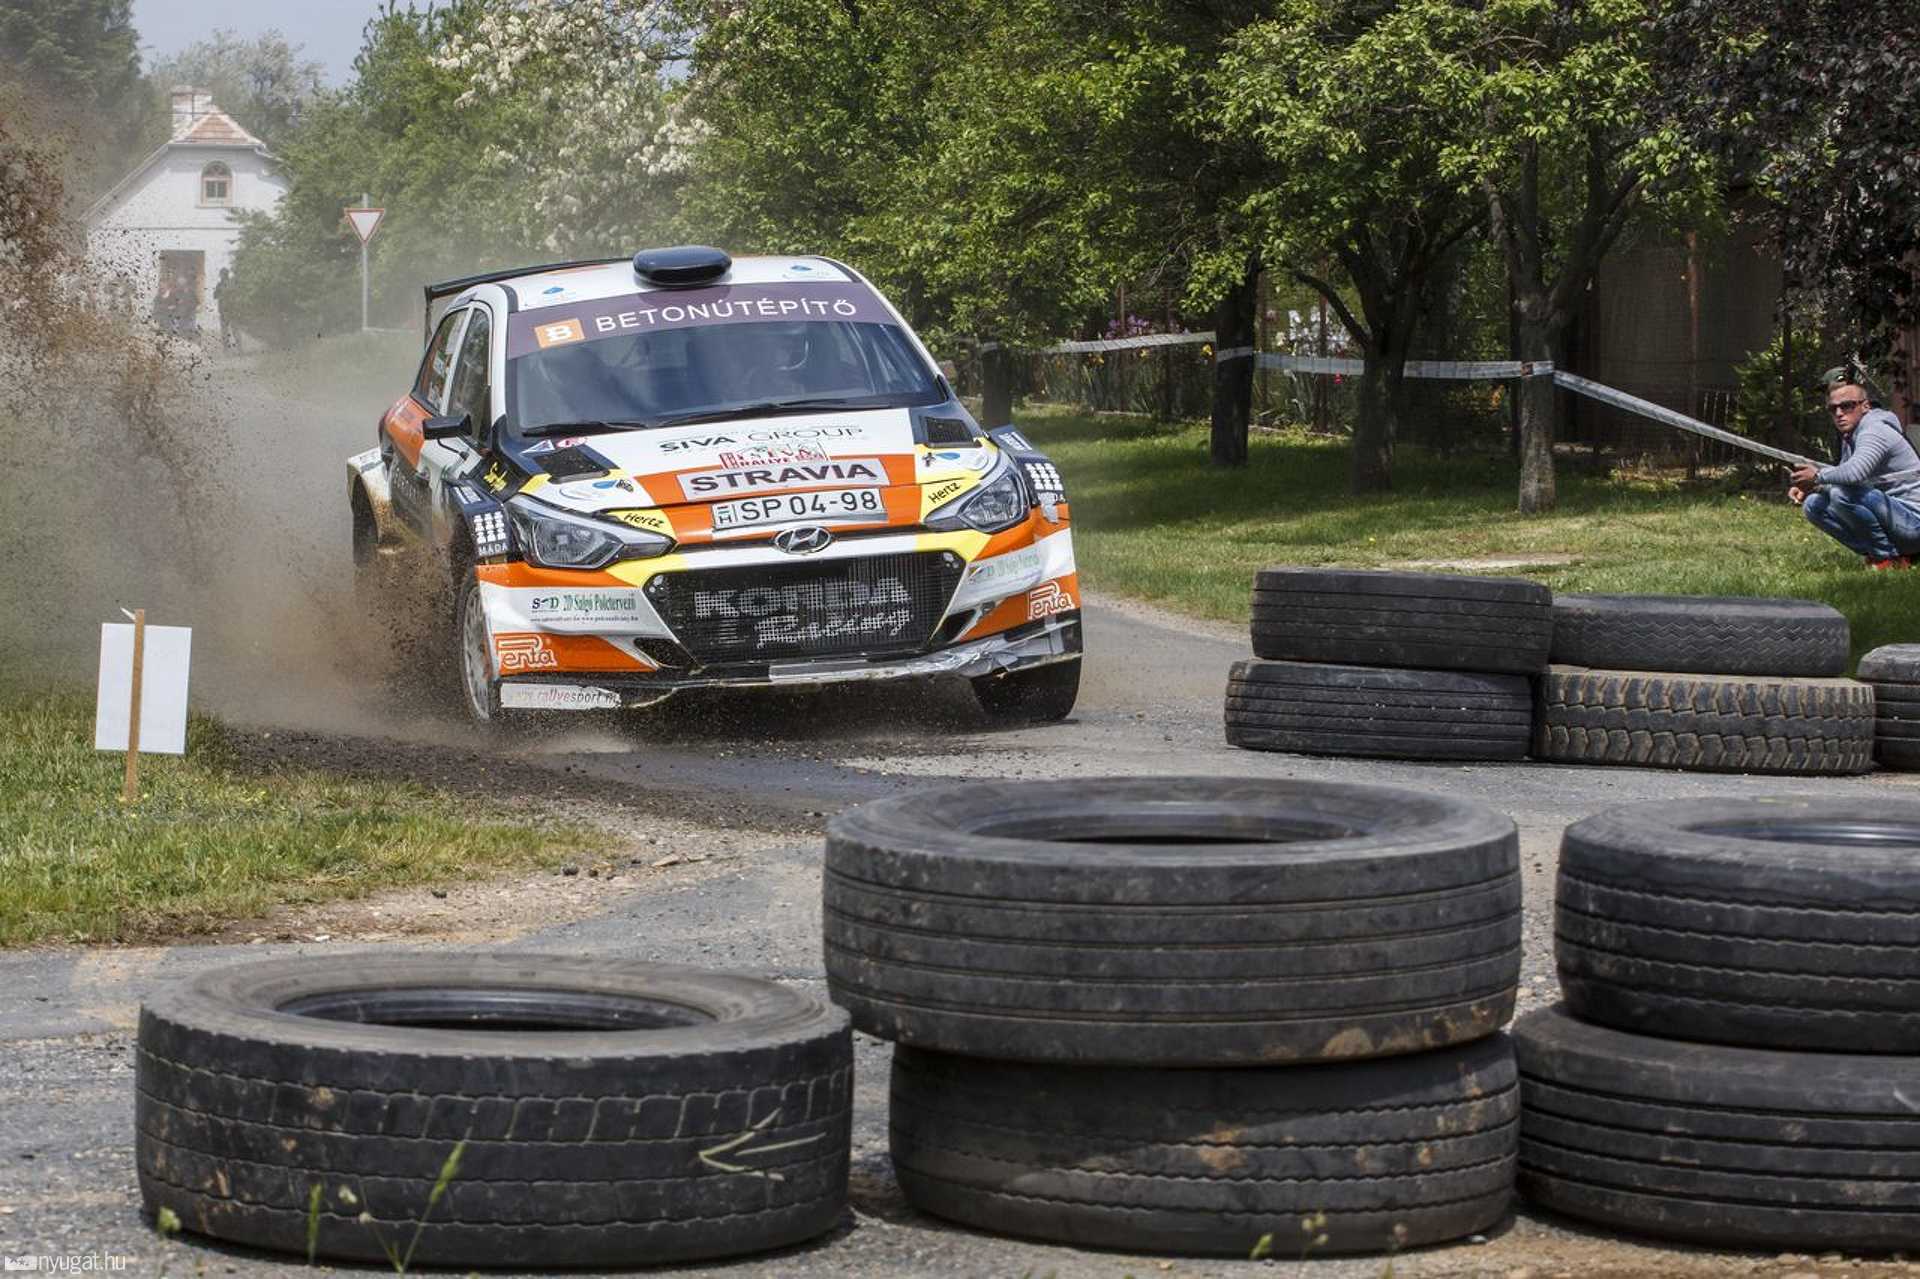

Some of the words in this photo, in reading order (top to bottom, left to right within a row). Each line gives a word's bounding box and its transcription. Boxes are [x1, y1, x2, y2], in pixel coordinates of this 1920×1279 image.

[595, 297, 857, 333] BETONÚTÉPÍTŐ
[659, 434, 736, 452] SIVA
[747, 426, 864, 442] GROUP
[689, 463, 878, 492] STRAVIA
[741, 501, 782, 521] SP
[790, 491, 878, 516] 04-98
[927, 482, 962, 504] Hertz
[623, 512, 665, 529] Hertz
[496, 633, 558, 670] Penta
